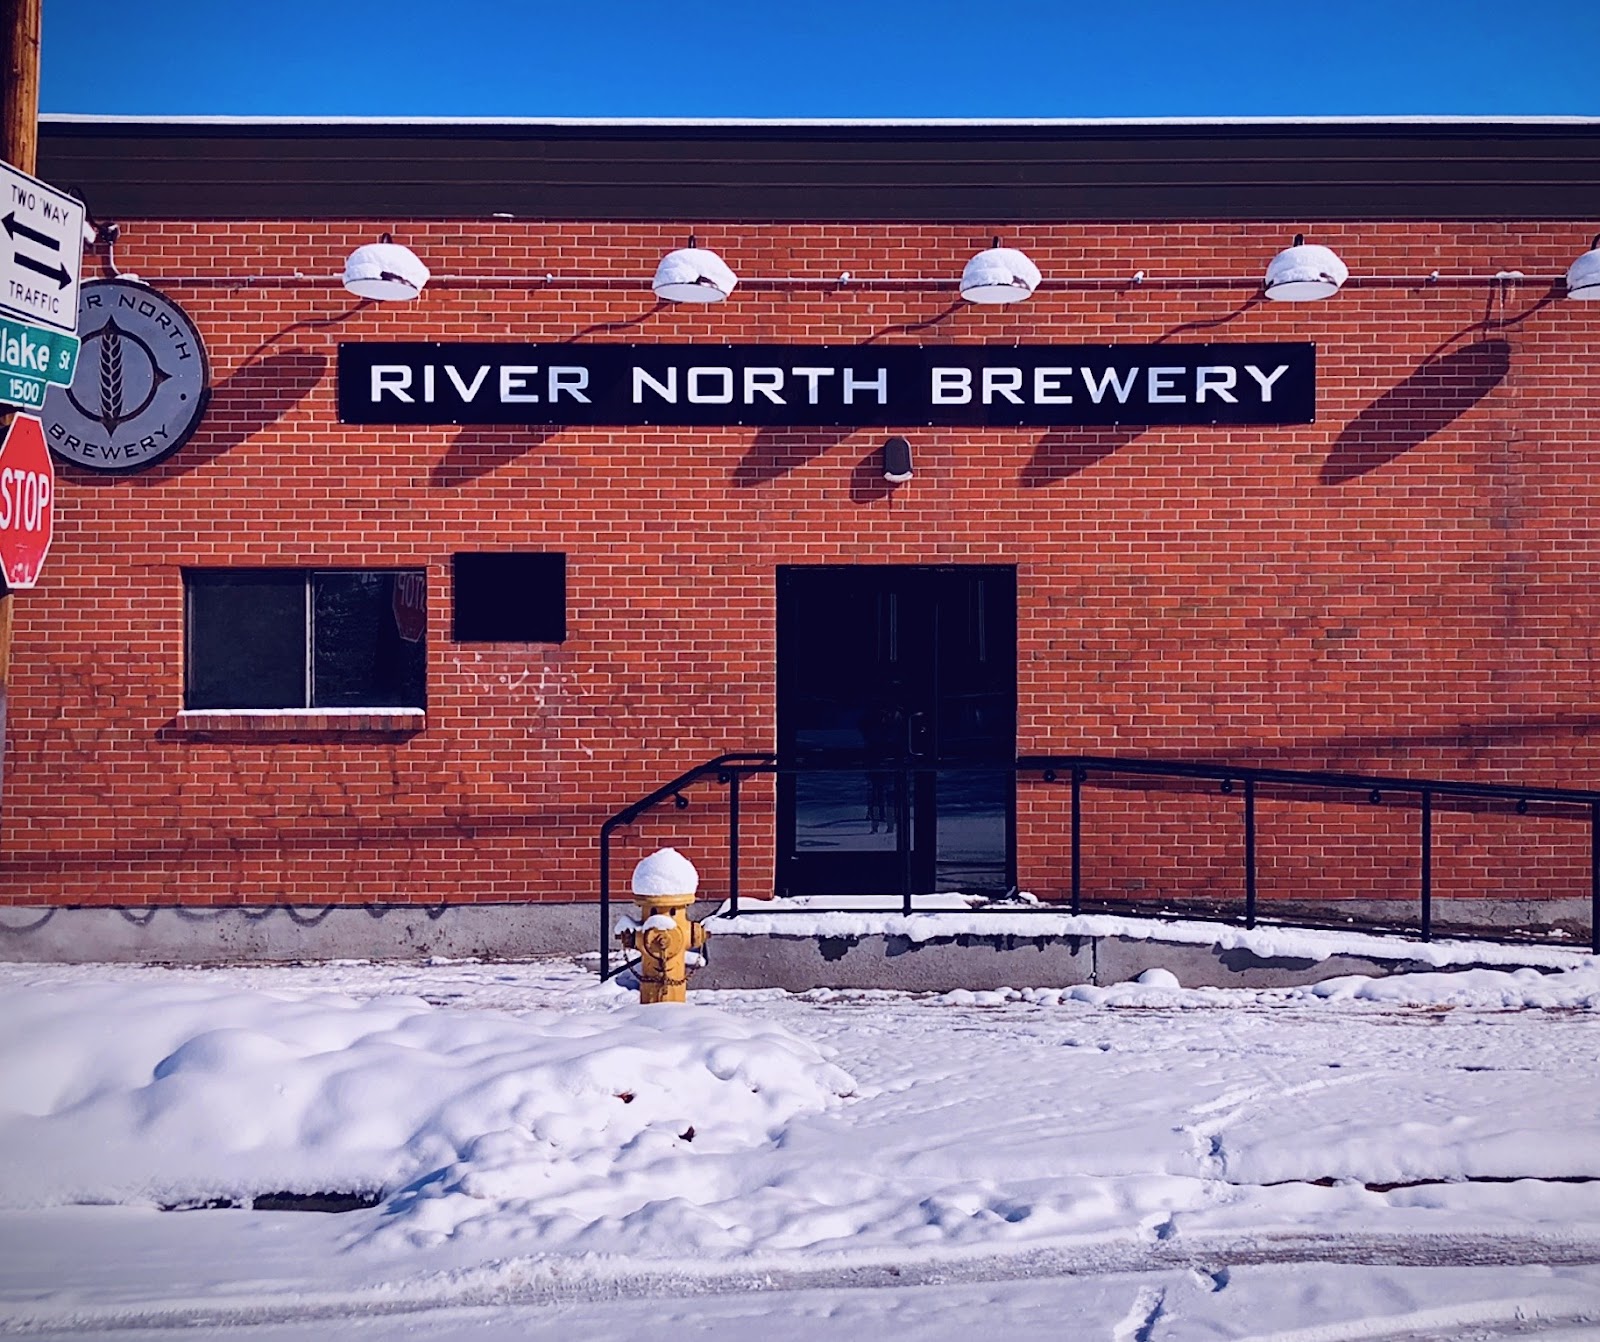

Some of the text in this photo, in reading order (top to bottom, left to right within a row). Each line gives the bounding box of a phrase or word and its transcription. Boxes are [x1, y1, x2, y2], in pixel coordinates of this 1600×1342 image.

[11, 184, 70, 226] TWO WAY
[9, 280, 60, 314] TRAFFIC
[118, 294, 192, 361] NORTH
[0, 327, 70, 372] lake St
[9, 379, 40, 402] 1500
[371, 364, 1290, 405] RIVER NORTH BREWERY
[48, 422, 169, 460] BREWERY
[0, 467, 50, 532] STOP
